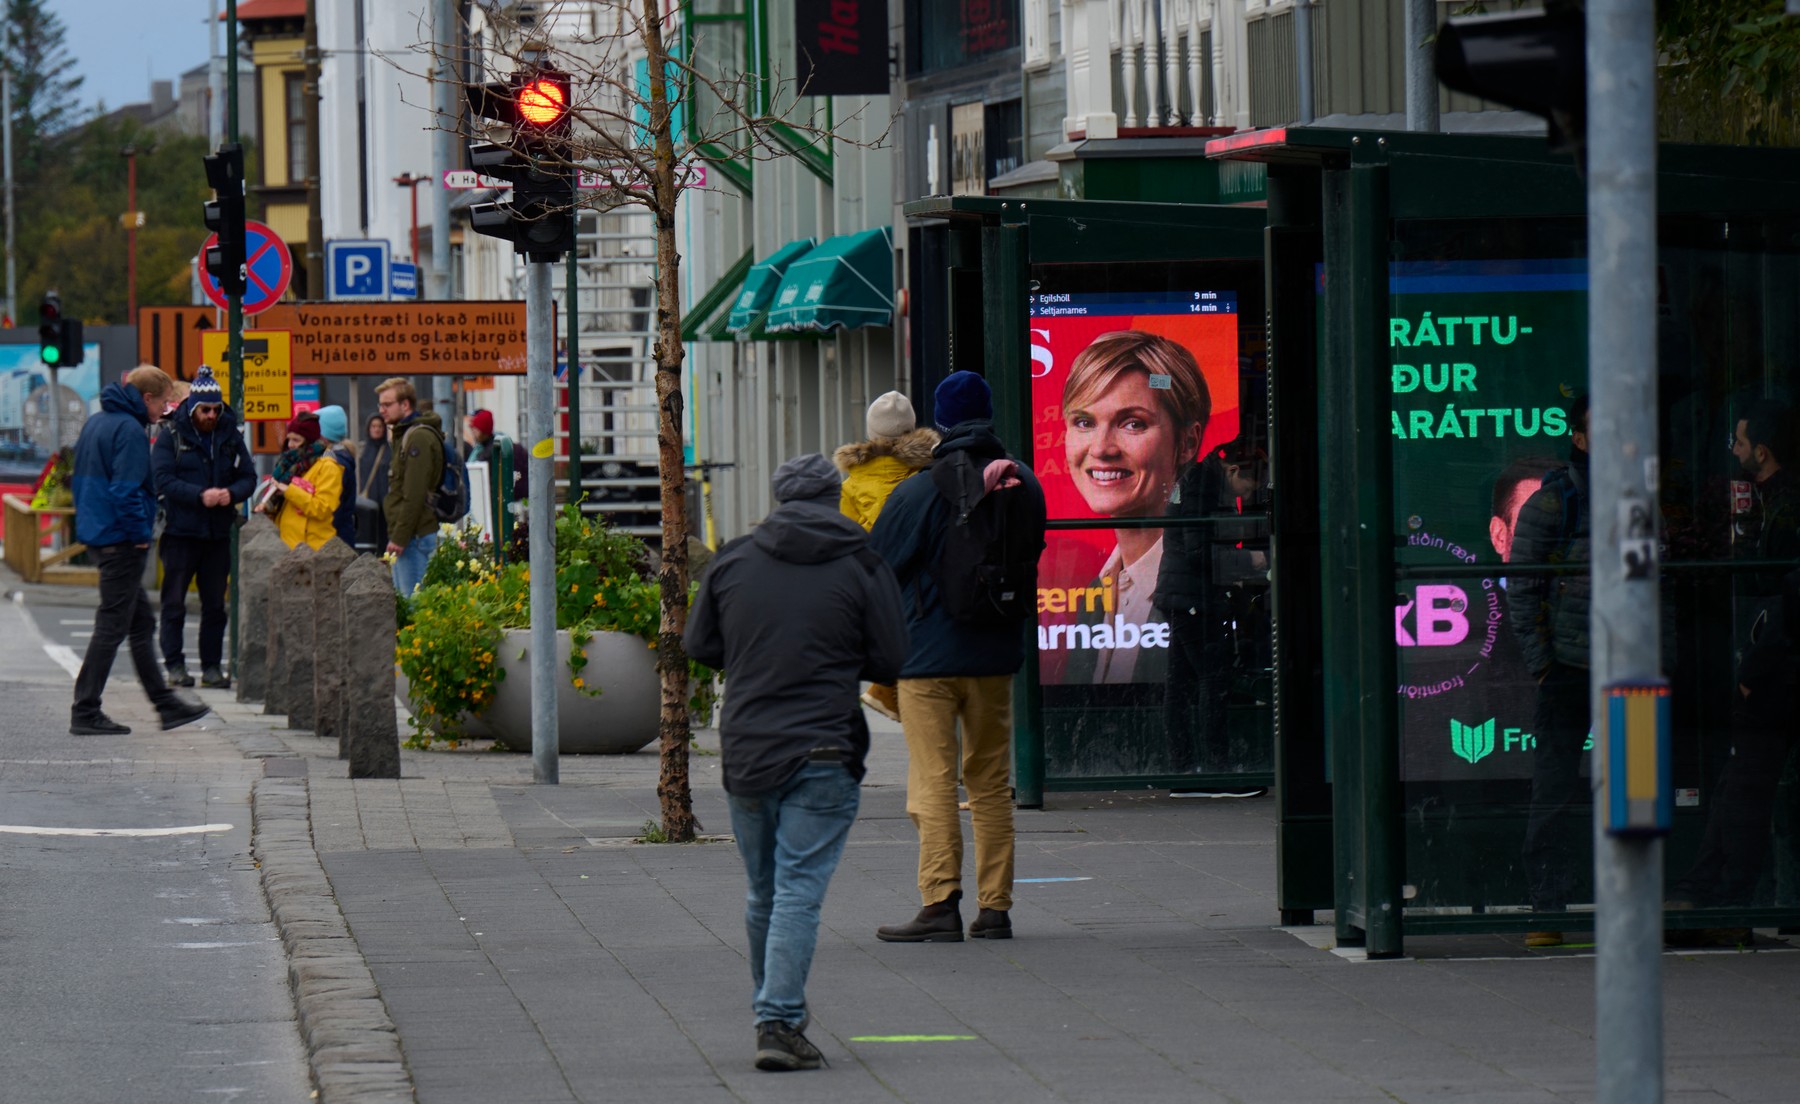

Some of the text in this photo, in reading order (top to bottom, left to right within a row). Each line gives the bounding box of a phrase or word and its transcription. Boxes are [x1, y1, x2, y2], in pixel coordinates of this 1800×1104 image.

[346, 255, 371, 288] P
[1040, 290, 1217, 305] Egilshöll 9 min
[1190, 304, 1201, 312] 14
[1201, 303, 1217, 312] min
[298, 312, 516, 327] Vonarstræti lokað milli
[1390, 311, 1533, 347] RÁTTU-
[411, 333, 430, 345] og
[434, 330, 527, 345] Lækjargöt
[311, 348, 377, 364] Hjáleið
[385, 351, 411, 362] um
[419, 347, 501, 361] Skólabrú
[246, 401, 280, 413] 25m
[1036, 576, 1114, 613] ærri
